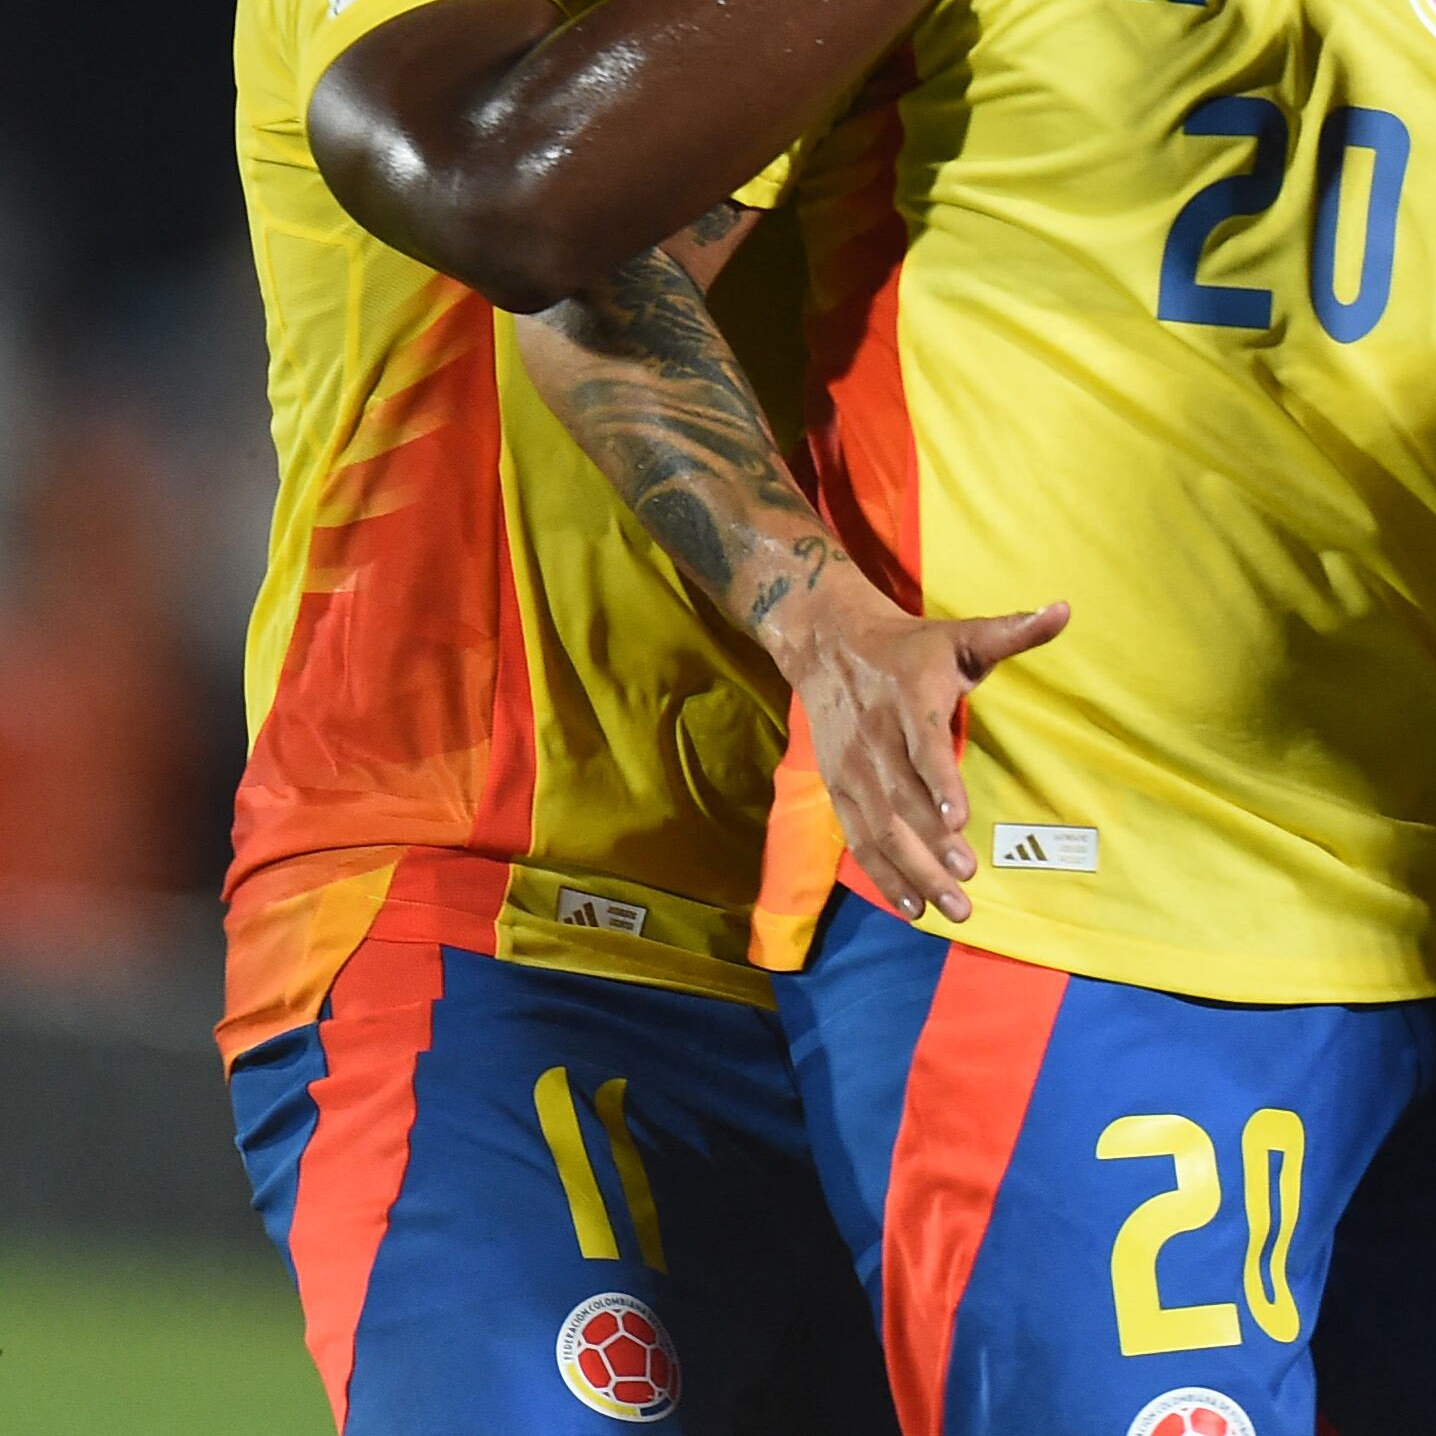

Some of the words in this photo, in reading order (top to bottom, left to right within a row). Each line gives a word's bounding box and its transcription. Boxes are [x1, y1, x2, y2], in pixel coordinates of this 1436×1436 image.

[1157, 95, 1411, 344] 20
[533, 1065, 669, 1275] 11
[1095, 1107, 1306, 1357] 20
